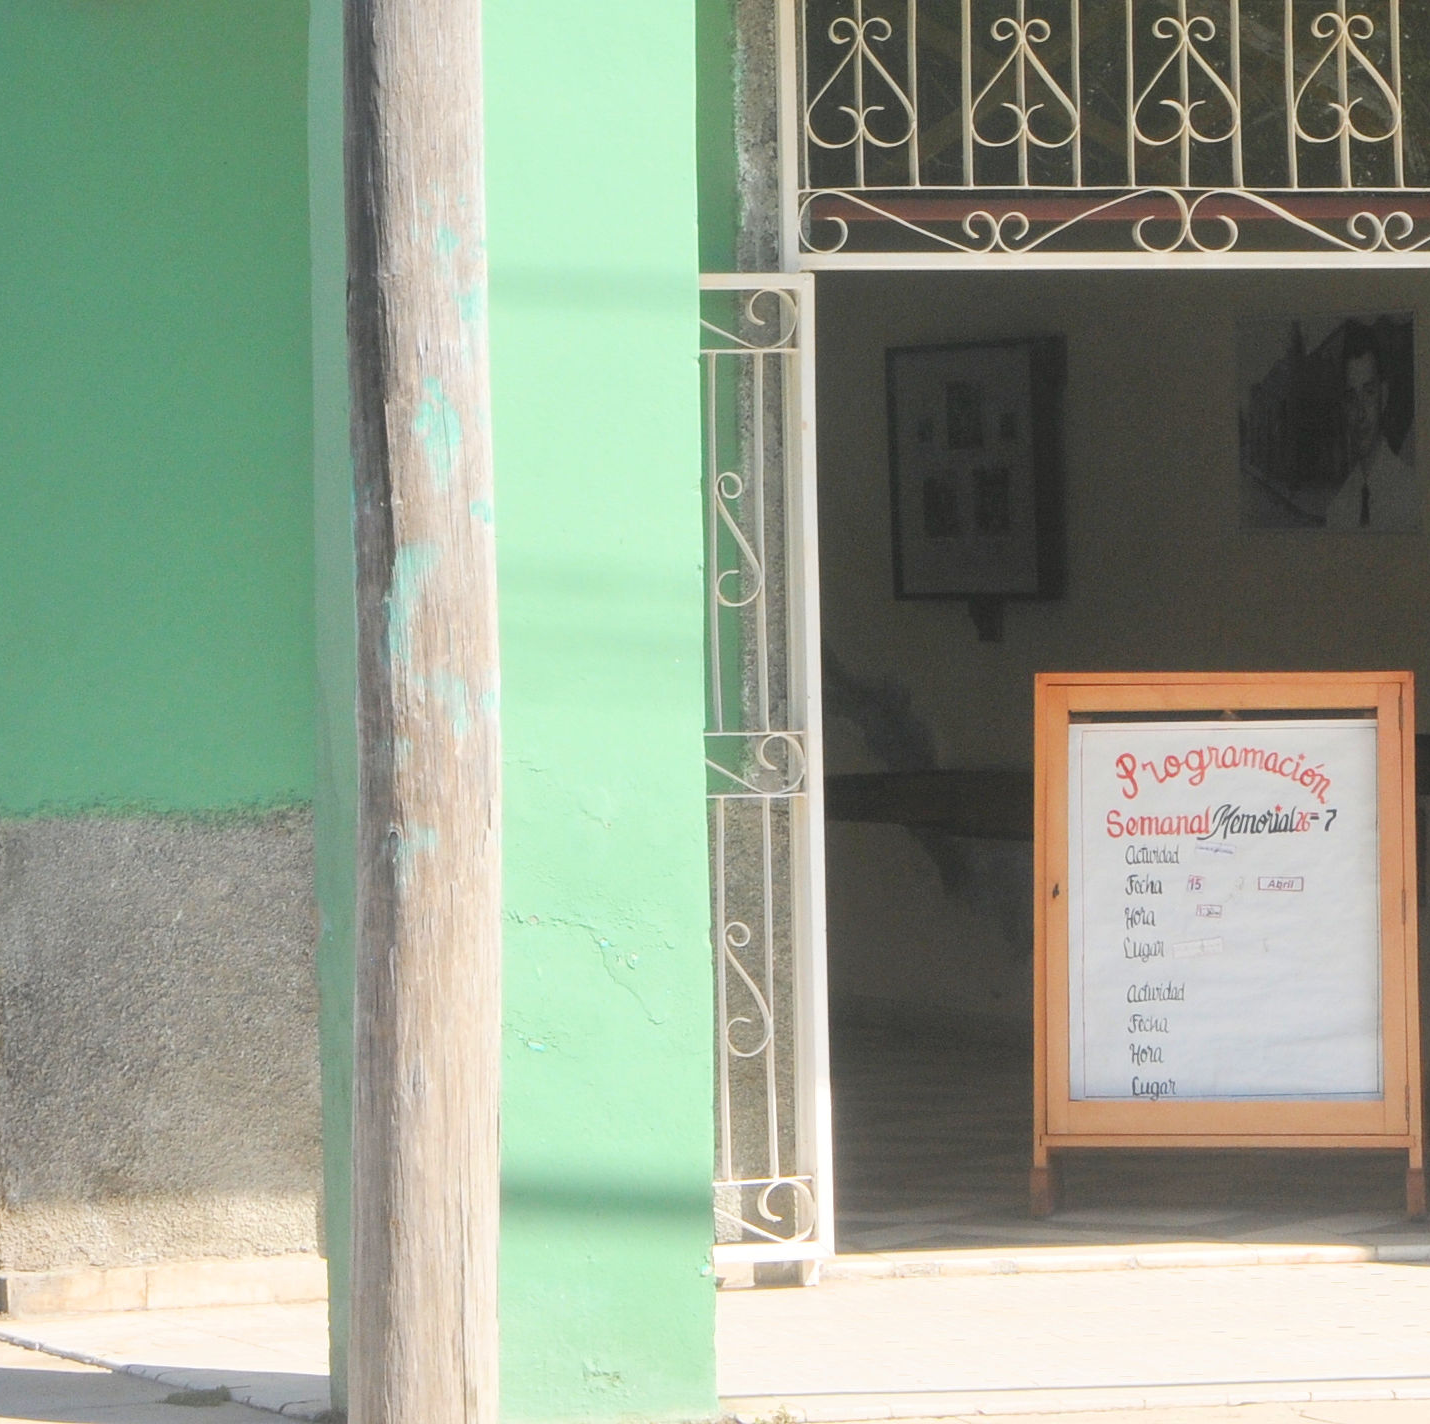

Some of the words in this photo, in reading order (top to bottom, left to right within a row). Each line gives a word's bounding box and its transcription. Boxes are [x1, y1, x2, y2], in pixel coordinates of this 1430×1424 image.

[1115, 745, 1332, 805] Programación
[1106, 805, 1212, 839] Semanal
[1196, 803, 1298, 840] Memorial
[1124, 874, 1163, 896] Fecha
[1266, 878, 1295, 890] Abril
[1124, 907, 1156, 929] Hora
[1123, 937, 1165, 963] Lugar
[1128, 1042, 1164, 1066] Hora
[1131, 1075, 1178, 1102] Lugar
